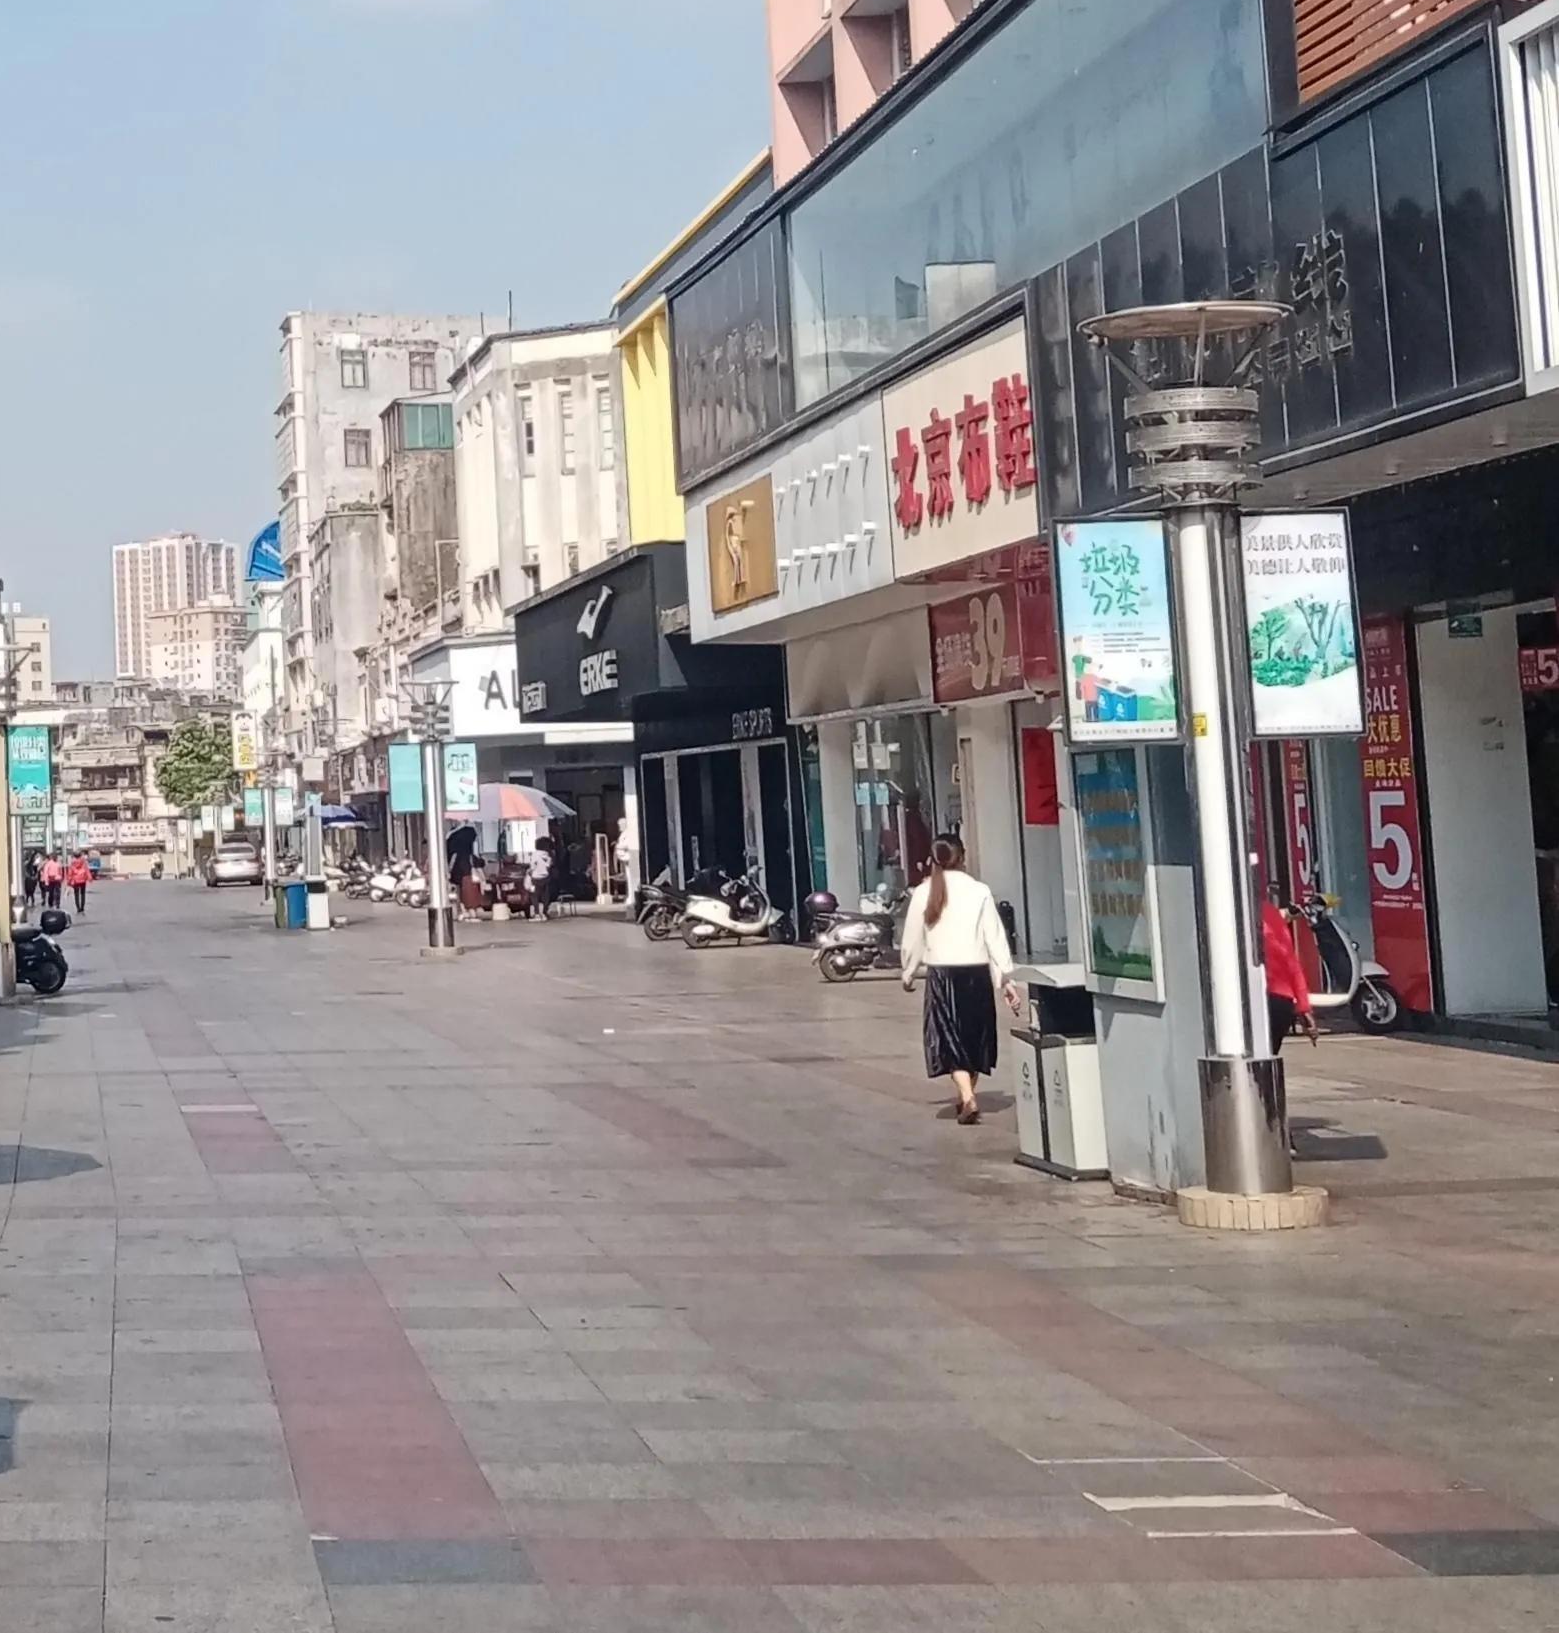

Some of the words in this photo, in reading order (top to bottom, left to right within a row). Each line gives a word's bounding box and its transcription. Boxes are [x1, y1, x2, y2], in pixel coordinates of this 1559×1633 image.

[891, 372, 1037, 531] 北京布鞋
[1079, 542, 1140, 576] 垃圾
[1090, 575, 1140, 616] 分类
[969, 593, 1005, 690] 39
[580, 649, 618, 696] ERKE
[1365, 685, 1399, 713] SALE
[1367, 714, 1402, 744] 大优惠
[1369, 790, 1413, 889] 5
